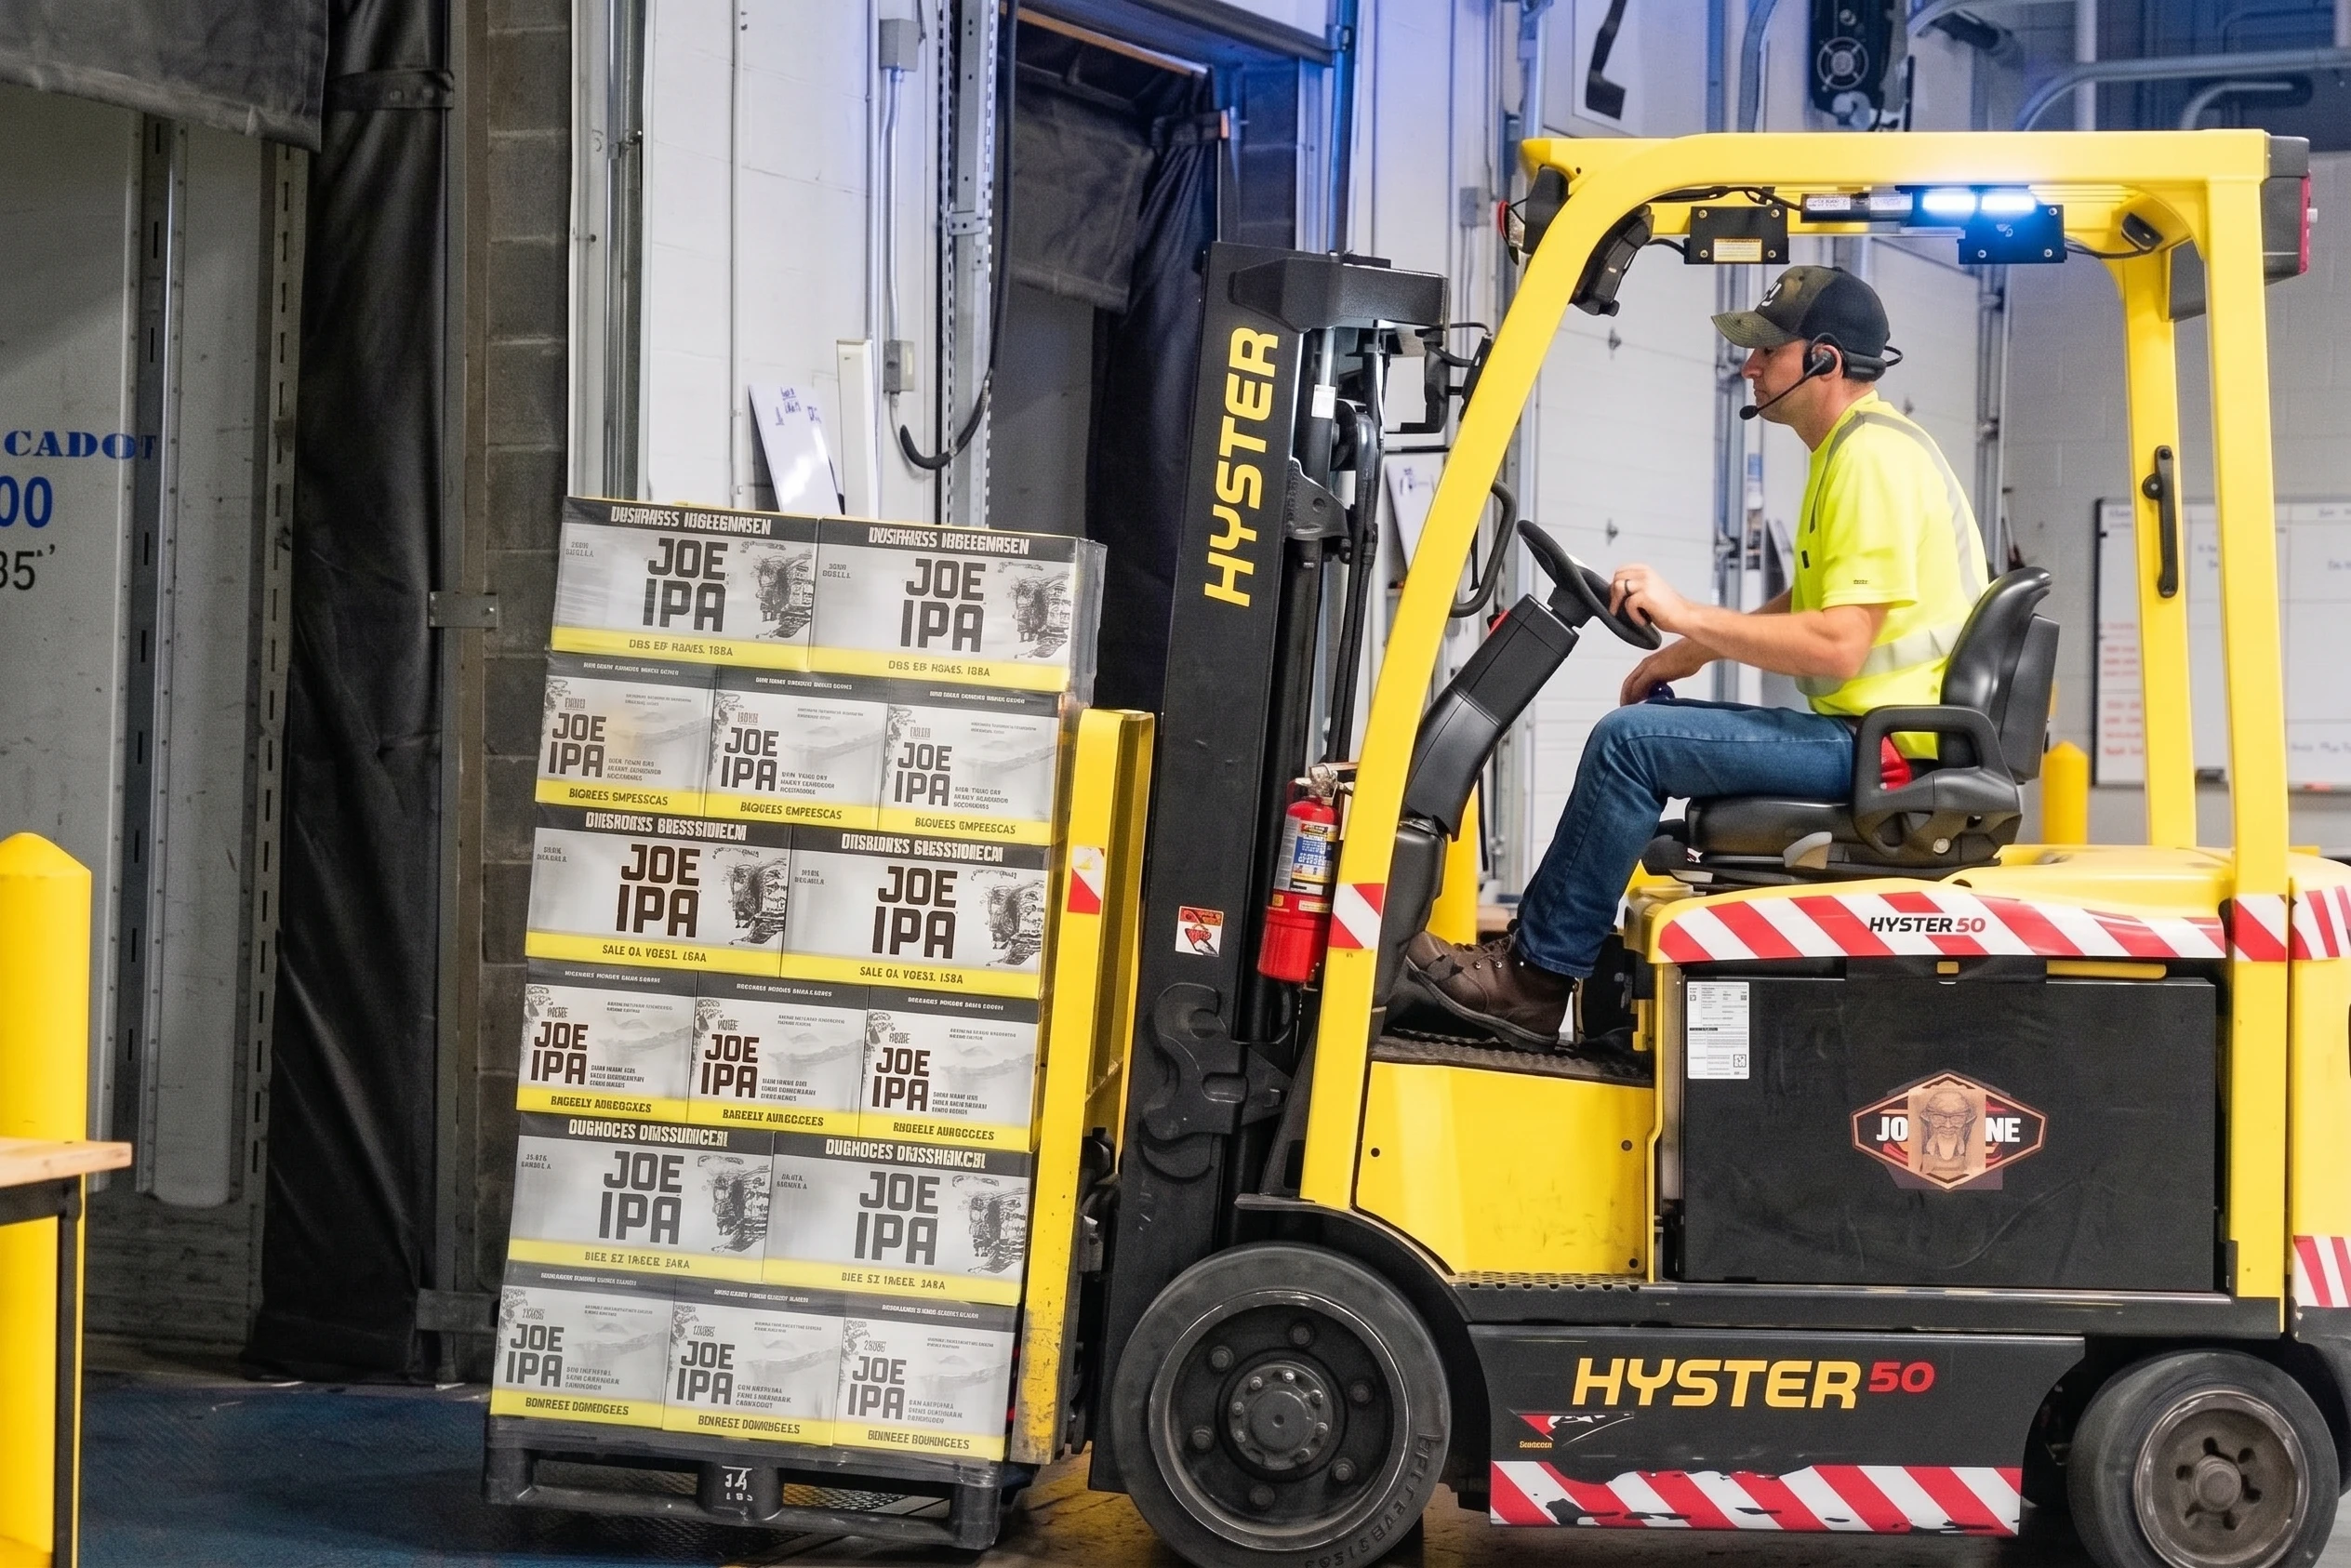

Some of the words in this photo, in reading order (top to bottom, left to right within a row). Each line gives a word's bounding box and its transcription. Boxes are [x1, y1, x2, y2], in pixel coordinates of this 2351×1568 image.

[1204, 326, 1279, 607] HYSTER
[647, 538, 728, 580] JOE
[906, 558, 986, 601] JOE
[643, 578, 726, 631] IPA
[900, 599, 985, 653] IPA
[552, 712, 606, 742] JOE
[724, 727, 779, 757] JOE
[549, 742, 604, 777] IPA
[721, 756, 777, 791] IPA
[897, 742, 952, 771] JOE
[895, 771, 950, 806] IPA
[621, 844, 700, 886] JOE
[878, 866, 958, 908] JOE
[616, 884, 699, 937] IPA
[1869, 917, 1953, 933] HYSTER
[1956, 917, 1986, 932] 50
[872, 906, 955, 959] IPA
[535, 1021, 589, 1051] JOE
[705, 1034, 760, 1063] JOE
[531, 1050, 587, 1085] IPA
[701, 1062, 758, 1098] IPA
[876, 1047, 931, 1077] JOE
[872, 1076, 929, 1111] IPA
[604, 1150, 684, 1193] JOE
[859, 1171, 940, 1214] JOE
[599, 1191, 682, 1245] IPA
[855, 1212, 938, 1266] IPA
[511, 1323, 565, 1352] JOE
[681, 1341, 736, 1370] JOE
[506, 1351, 563, 1388] IPA
[676, 1368, 734, 1405] IPA
[852, 1356, 907, 1385] JOE
[1572, 1358, 1861, 1409] HYSTER
[1867, 1362, 1934, 1393] 50
[847, 1384, 905, 1420] IPA
